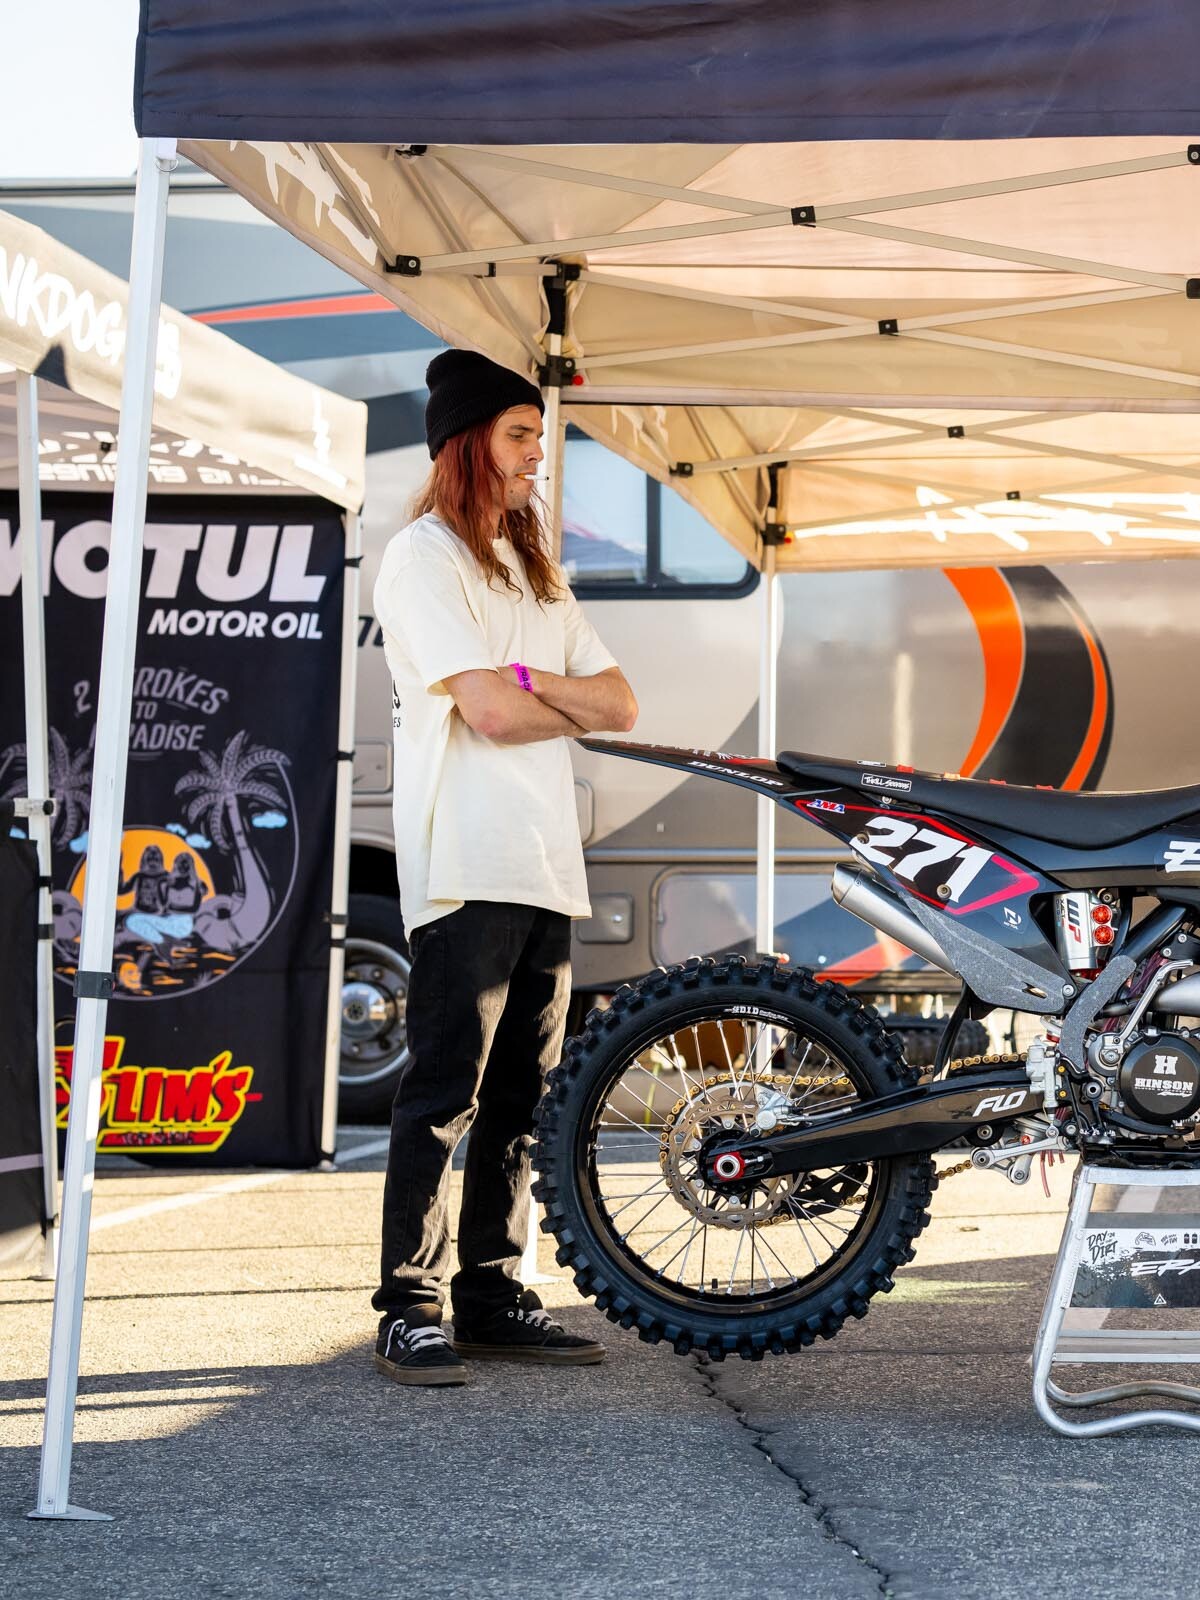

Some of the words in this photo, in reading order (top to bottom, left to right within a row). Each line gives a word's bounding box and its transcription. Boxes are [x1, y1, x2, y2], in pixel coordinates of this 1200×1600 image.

[147, 609, 266, 638] MOTOR
[271, 611, 323, 640] OIL
[73, 680, 93, 714] 2
[136, 700, 157, 720] TO
[687, 760, 784, 787] DUNLOP
[807, 799, 845, 814] AMA
[849, 816, 994, 902] 271
[1153, 1054, 1178, 1075] H
[1134, 1077, 1194, 1091] HINSON
[972, 1090, 1027, 1117] FLO
[1086, 1230, 1108, 1250] DAY
[1089, 1240, 1118, 1264] DIRT
